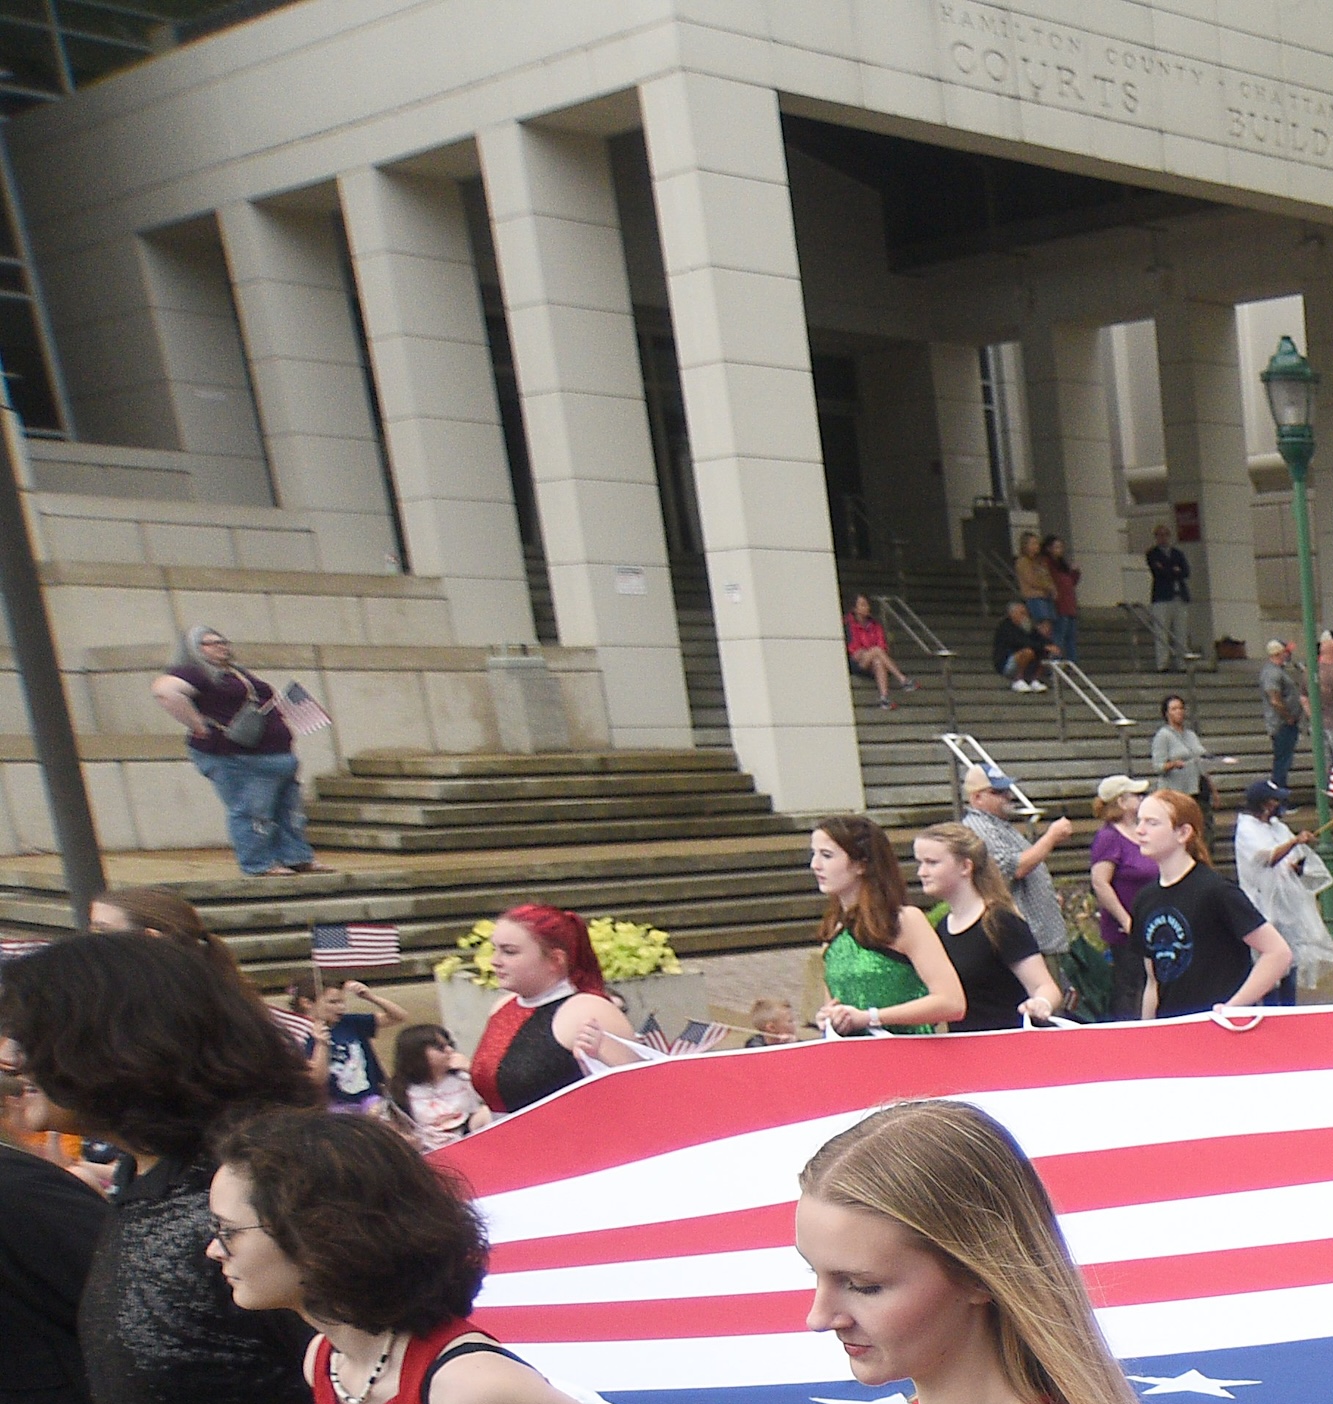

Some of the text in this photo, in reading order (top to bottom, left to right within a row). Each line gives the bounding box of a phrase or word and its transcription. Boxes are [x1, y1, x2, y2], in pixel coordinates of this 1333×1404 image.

[940, 4, 1082, 52] HAMILTON
[1106, 47, 1202, 82] COUNTY
[951, 41, 1138, 113] COURTS
